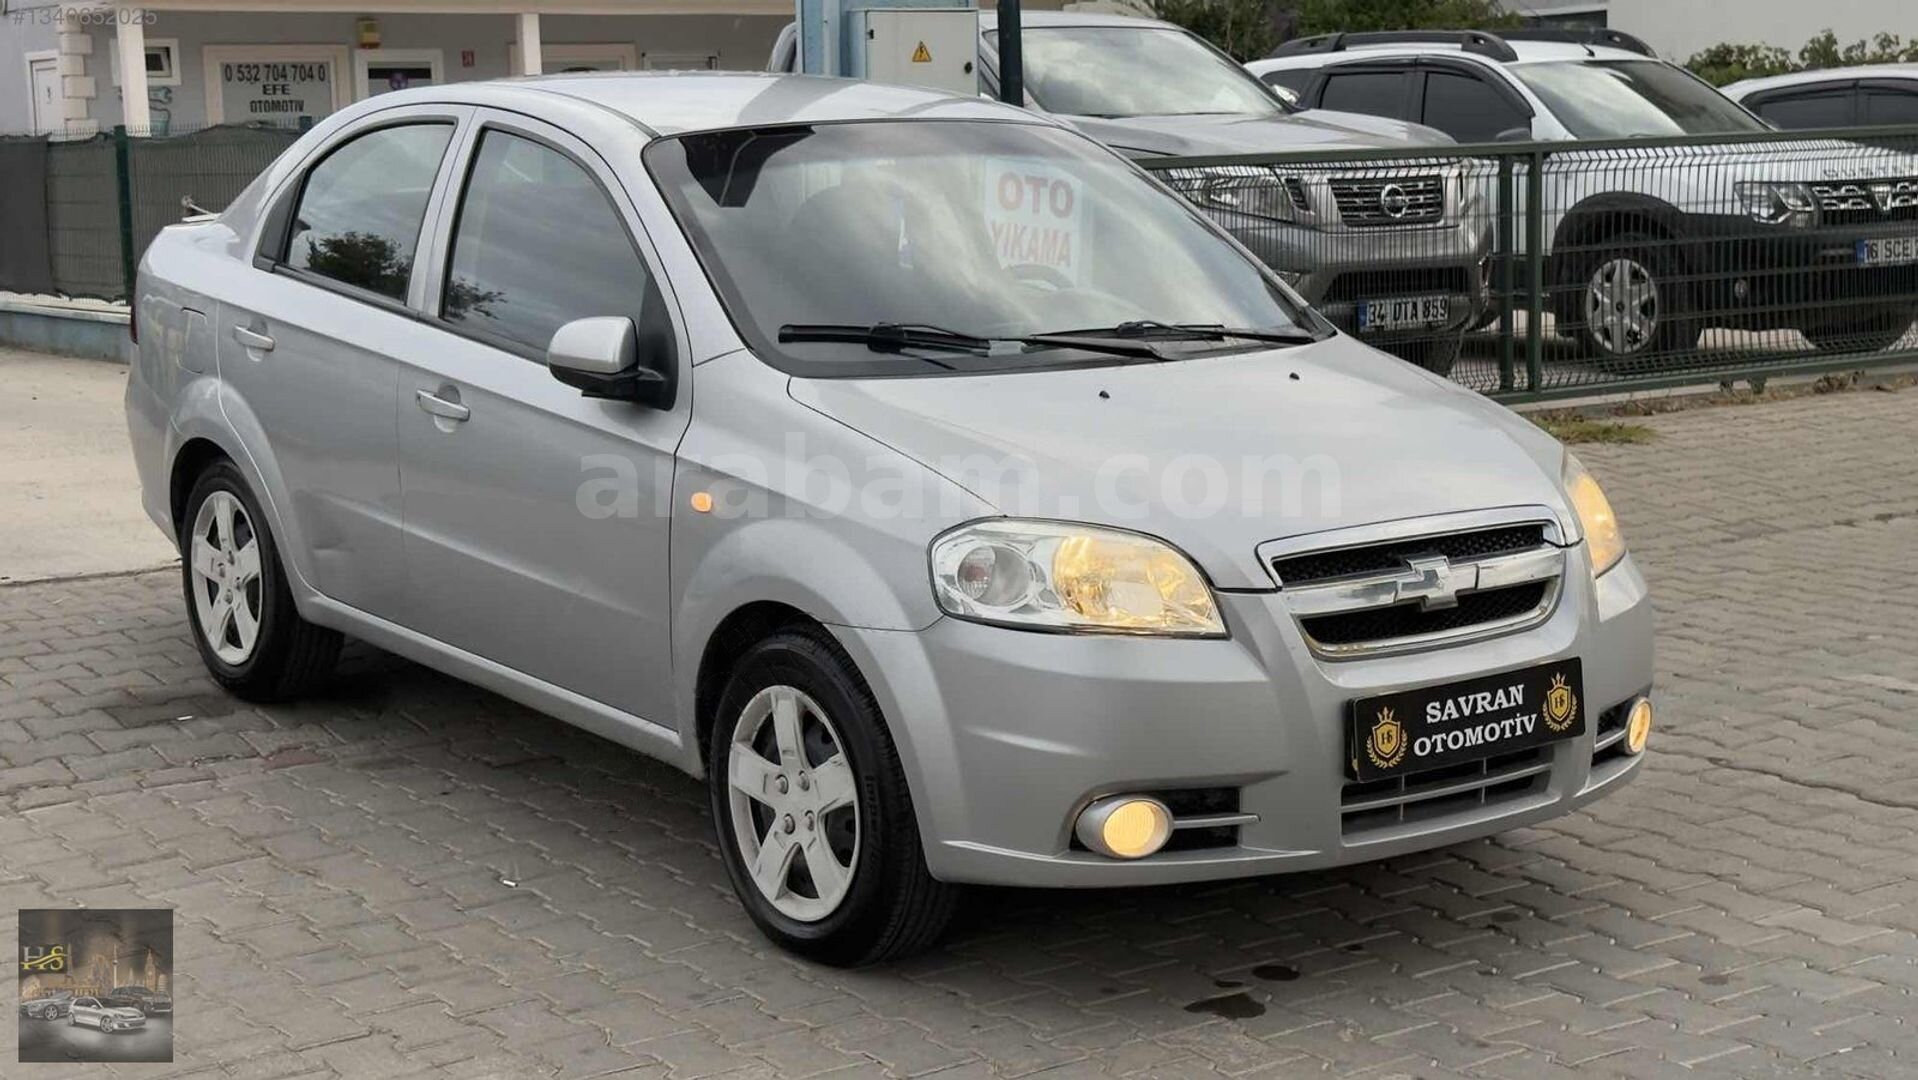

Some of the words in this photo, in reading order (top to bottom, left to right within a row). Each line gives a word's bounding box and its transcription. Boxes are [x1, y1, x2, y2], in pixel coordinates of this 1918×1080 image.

[224, 63, 233, 82] 0
[237, 63, 260, 82] 532
[264, 63, 288, 82] 704
[291, 63, 315, 82] 704
[318, 63, 326, 82] 0
[262, 83, 291, 96] EFE
[997, 171, 1073, 219] OTO
[1884, 240, 1910, 259] SCE
[1369, 303, 1385, 324] 34
[1425, 684, 1525, 724] SAVRAN
[1413, 713, 1538, 757] OTOMOTİV
